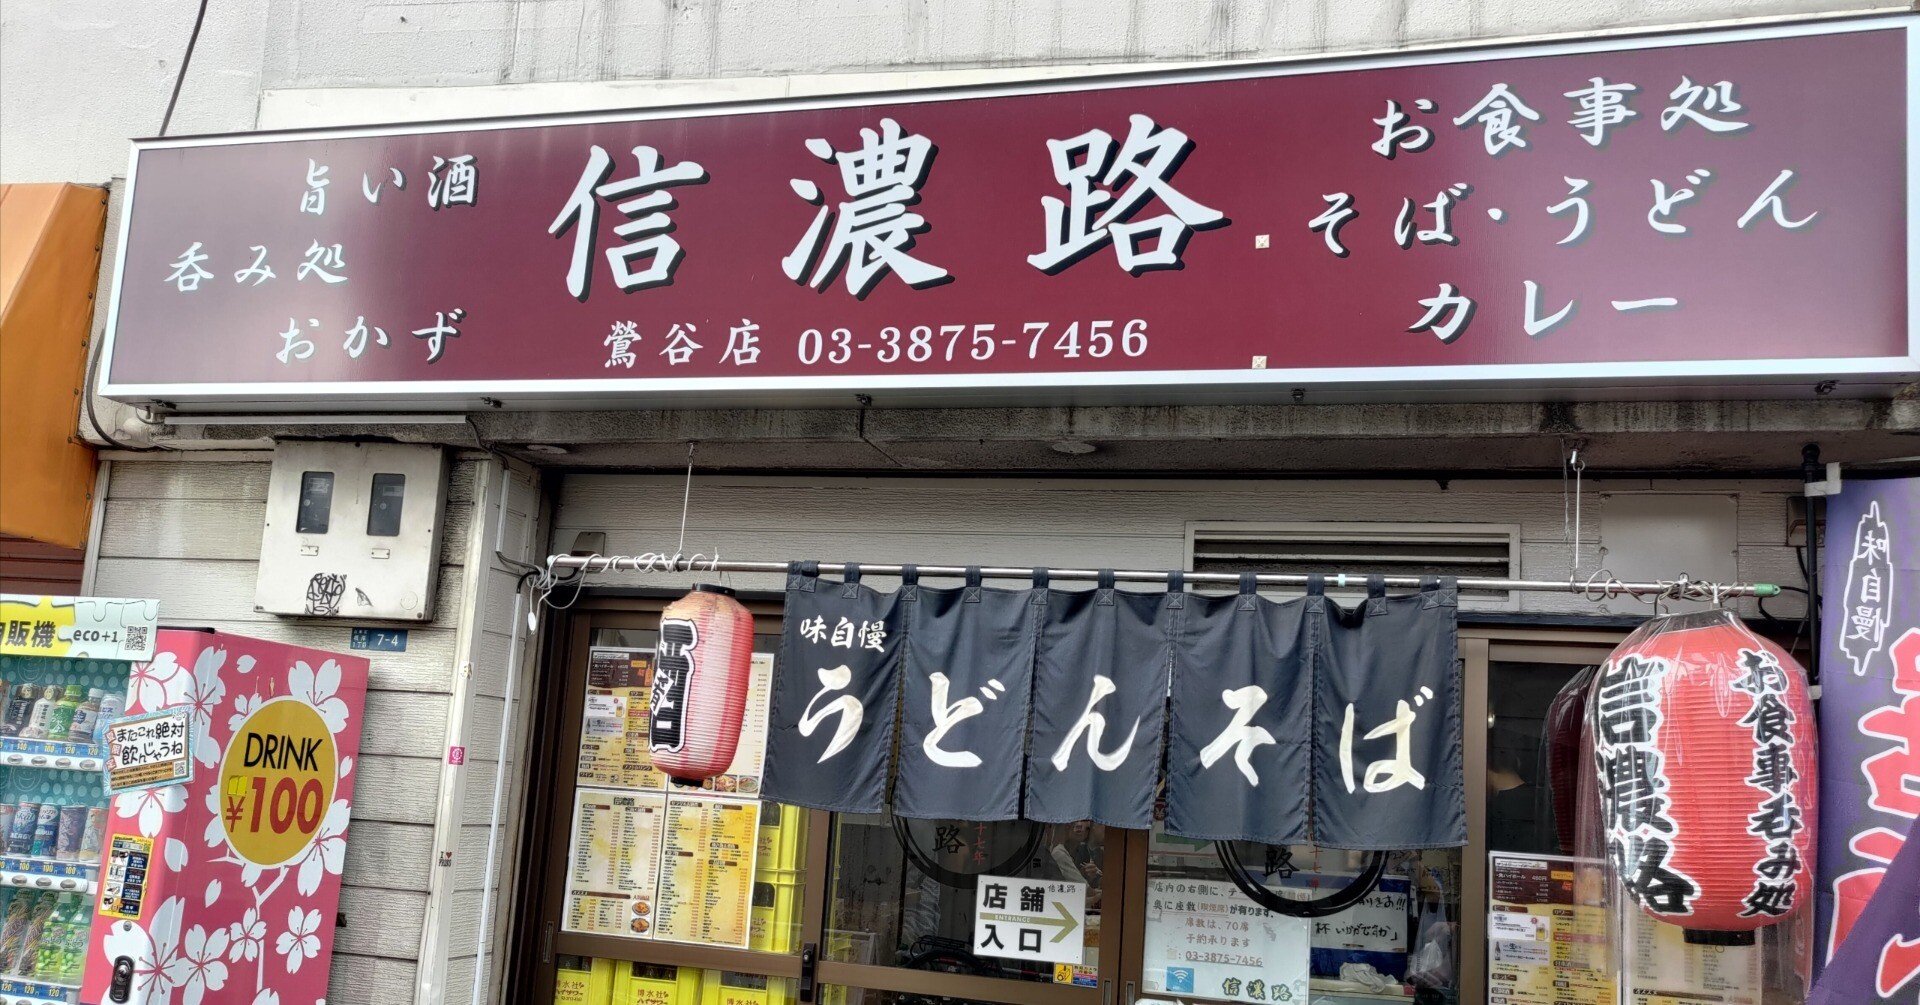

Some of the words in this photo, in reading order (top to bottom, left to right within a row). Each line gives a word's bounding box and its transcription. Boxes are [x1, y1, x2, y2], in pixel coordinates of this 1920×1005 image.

[1371, 75, 1749, 155] お食事処
[299, 154, 476, 216] 旨い酒
[548, 114, 1224, 298] 信濃路
[164, 239, 348, 292] 呑み処
[1408, 280, 1678, 341] カレー
[276, 308, 464, 364] おかず
[603, 319, 761, 369] 鶯谷店
[797, 319, 1148, 365] 03-3875-7456
[73, 629, 119, 643] eco+1
[377, 633, 399, 646] 7-4
[800, 615, 887, 653] 味自慢
[117, 722, 184, 743] またこれ絶対
[122, 741, 183, 765] 飲んじゃうね
[244, 732, 324, 772] DRINK
[1730, 650, 1802, 917] お食事呑み処
[932, 825, 967, 854] 路
[982, 883, 1046, 913] 店舗
[995, 914, 1031, 923] ENTRANCE
[980, 924, 1042, 953] 入口
[1186, 934, 1251, 948] 予約承ります
[1222, 976, 1293, 1001] 信濃路
